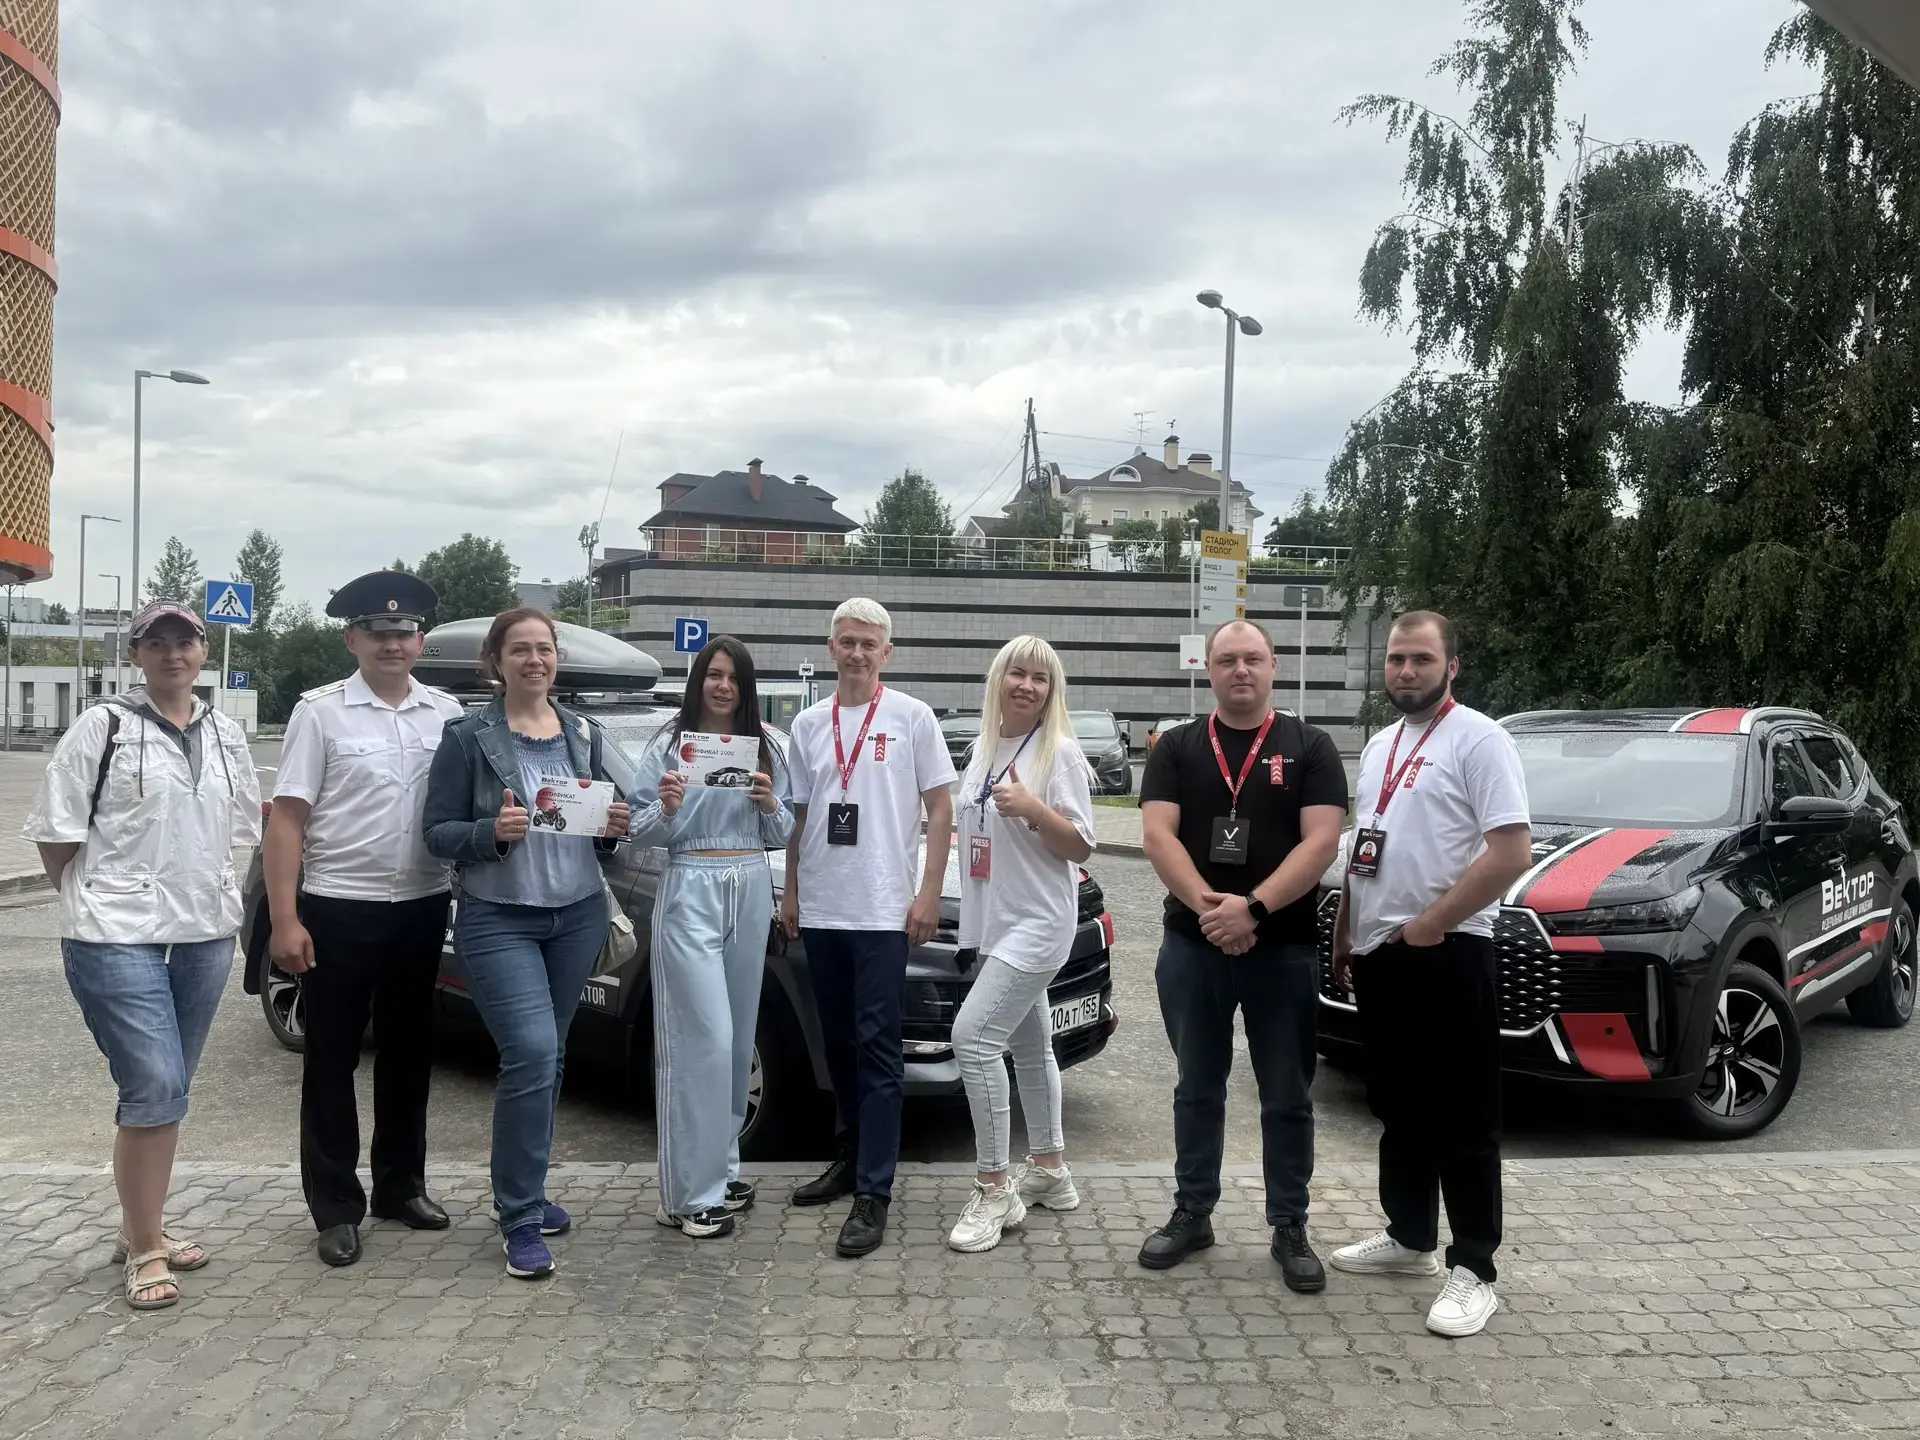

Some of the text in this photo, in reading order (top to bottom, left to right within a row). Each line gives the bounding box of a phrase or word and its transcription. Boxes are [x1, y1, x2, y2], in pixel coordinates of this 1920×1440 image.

[1205, 536, 1239, 546] СТАДИОН
[1205, 546, 1232, 555] ГЕОЛОГ
[684, 622, 702, 649] P
[423, 647, 440, 655] eco
[235, 675, 244, 685] P
[971, 837, 989, 848] PRESS
[1081, 996, 1097, 1015] 155
